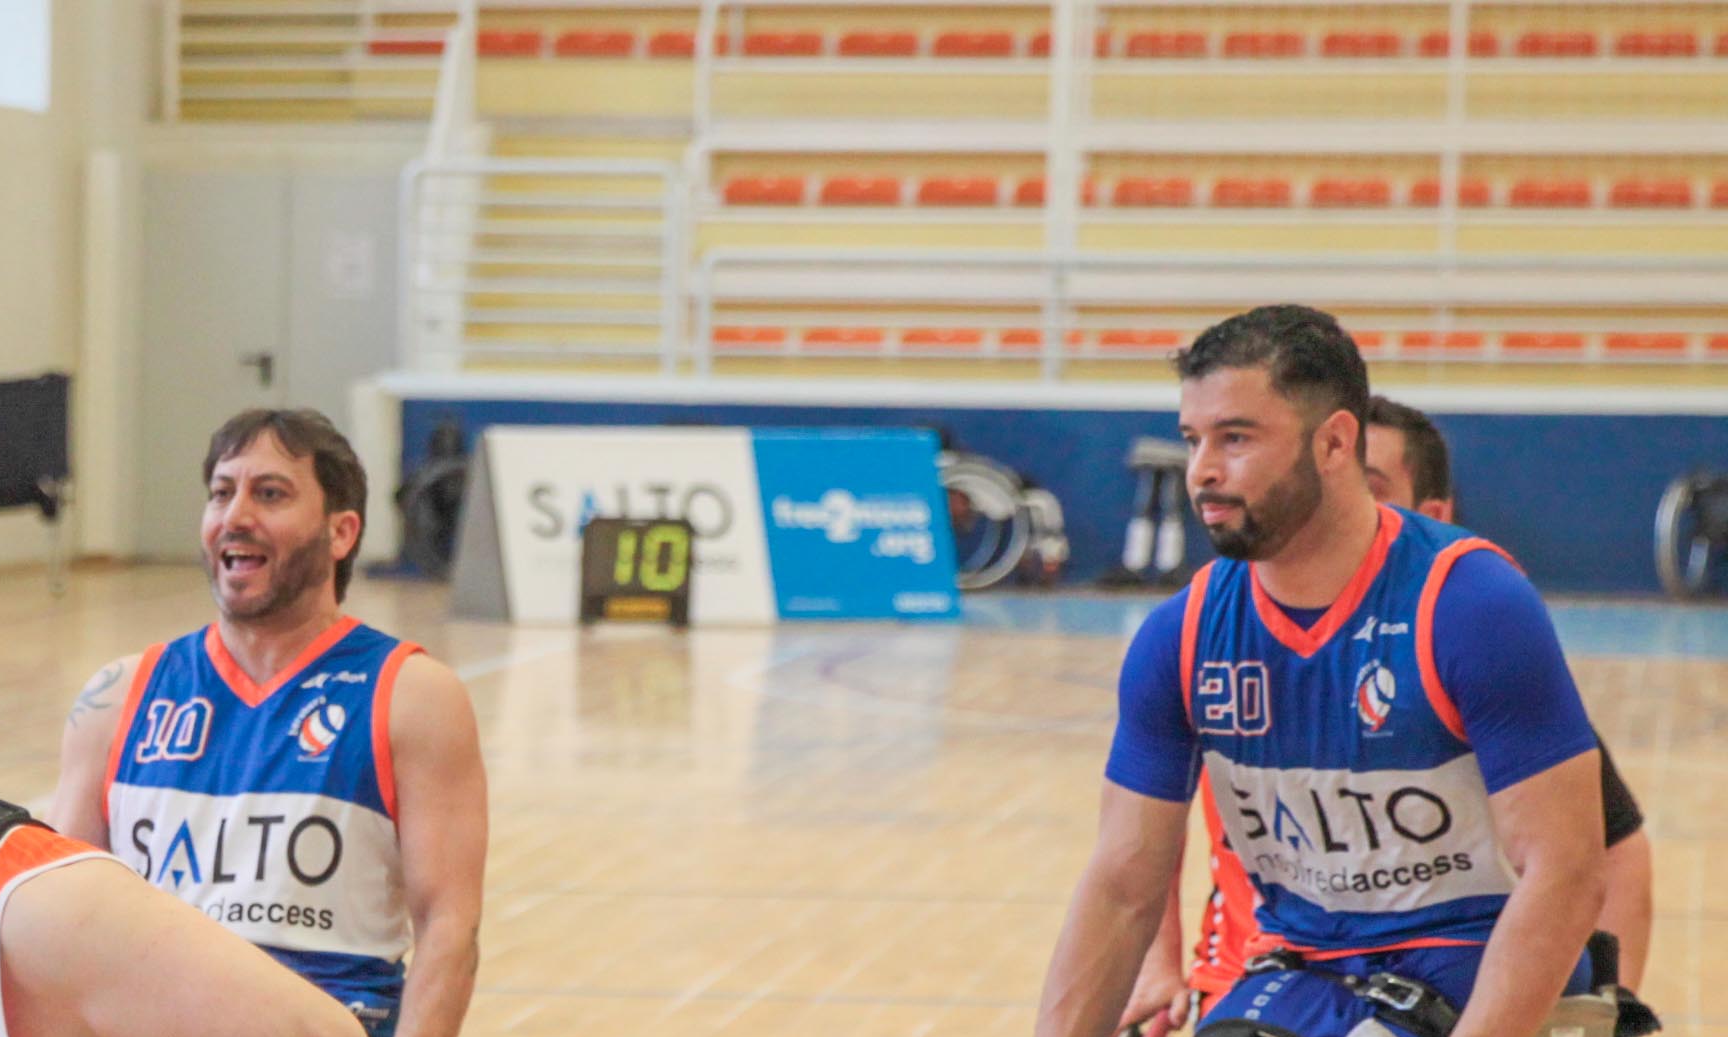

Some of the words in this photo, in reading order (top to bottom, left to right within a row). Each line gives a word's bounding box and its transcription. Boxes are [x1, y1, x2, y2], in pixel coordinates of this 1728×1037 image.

[614, 524, 690, 592] 10
[135, 696, 214, 764] 10
[1197, 659, 1272, 736] 20
[131, 814, 344, 890] SALTO
[1229, 781, 1453, 853] SALTO
